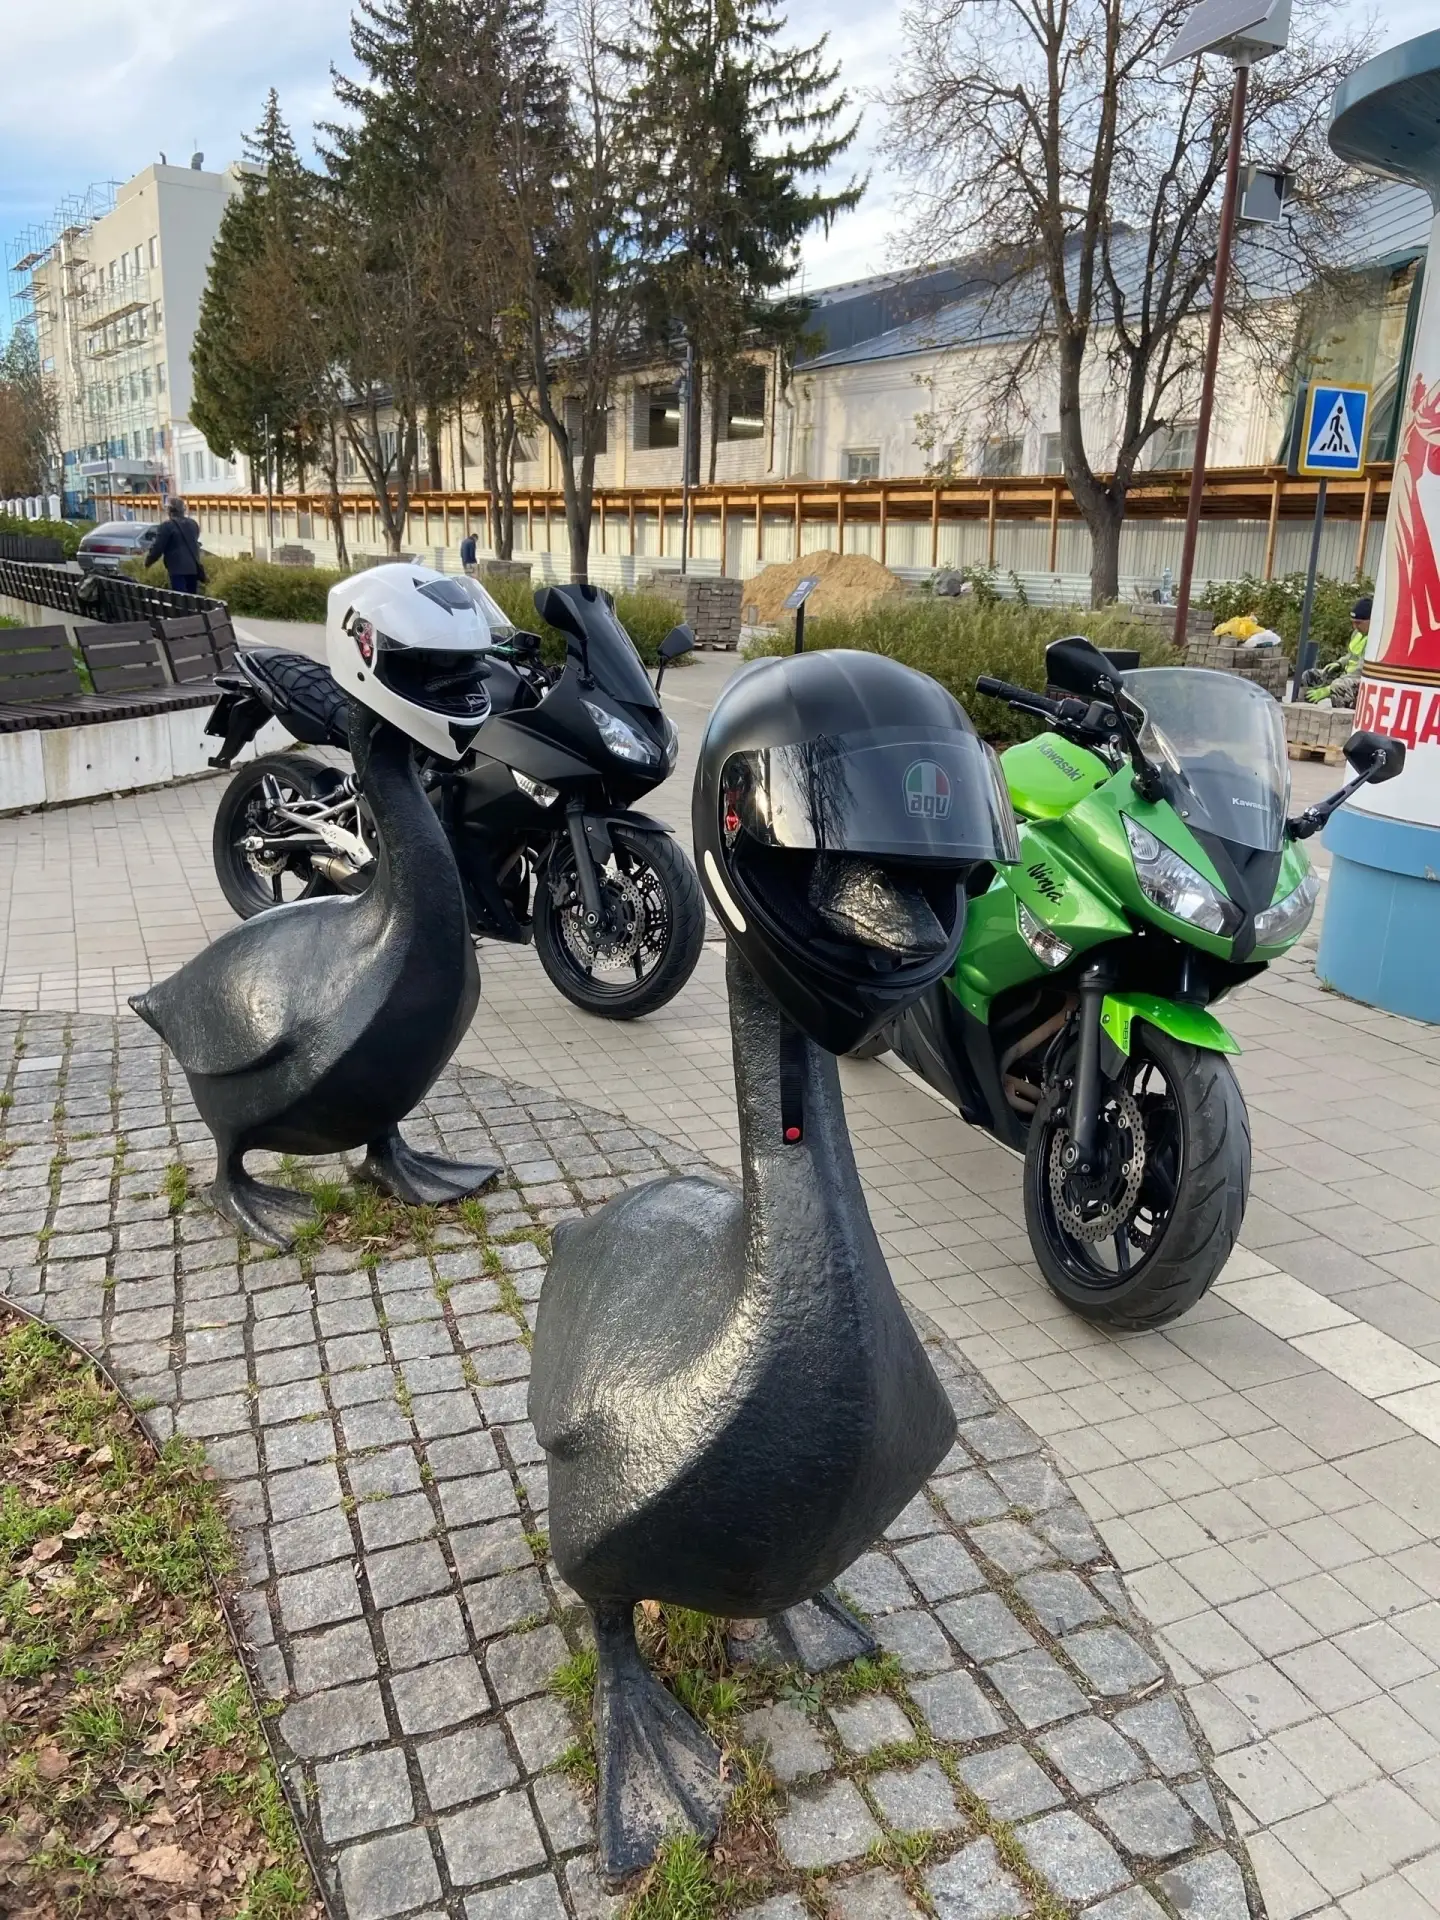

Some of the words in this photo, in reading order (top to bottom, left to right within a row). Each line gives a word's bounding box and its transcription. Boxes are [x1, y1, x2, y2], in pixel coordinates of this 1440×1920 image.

[1036, 743, 1085, 782] Kawasaki
[910, 793, 949, 819] agv
[1026, 862, 1064, 906] Ninja
